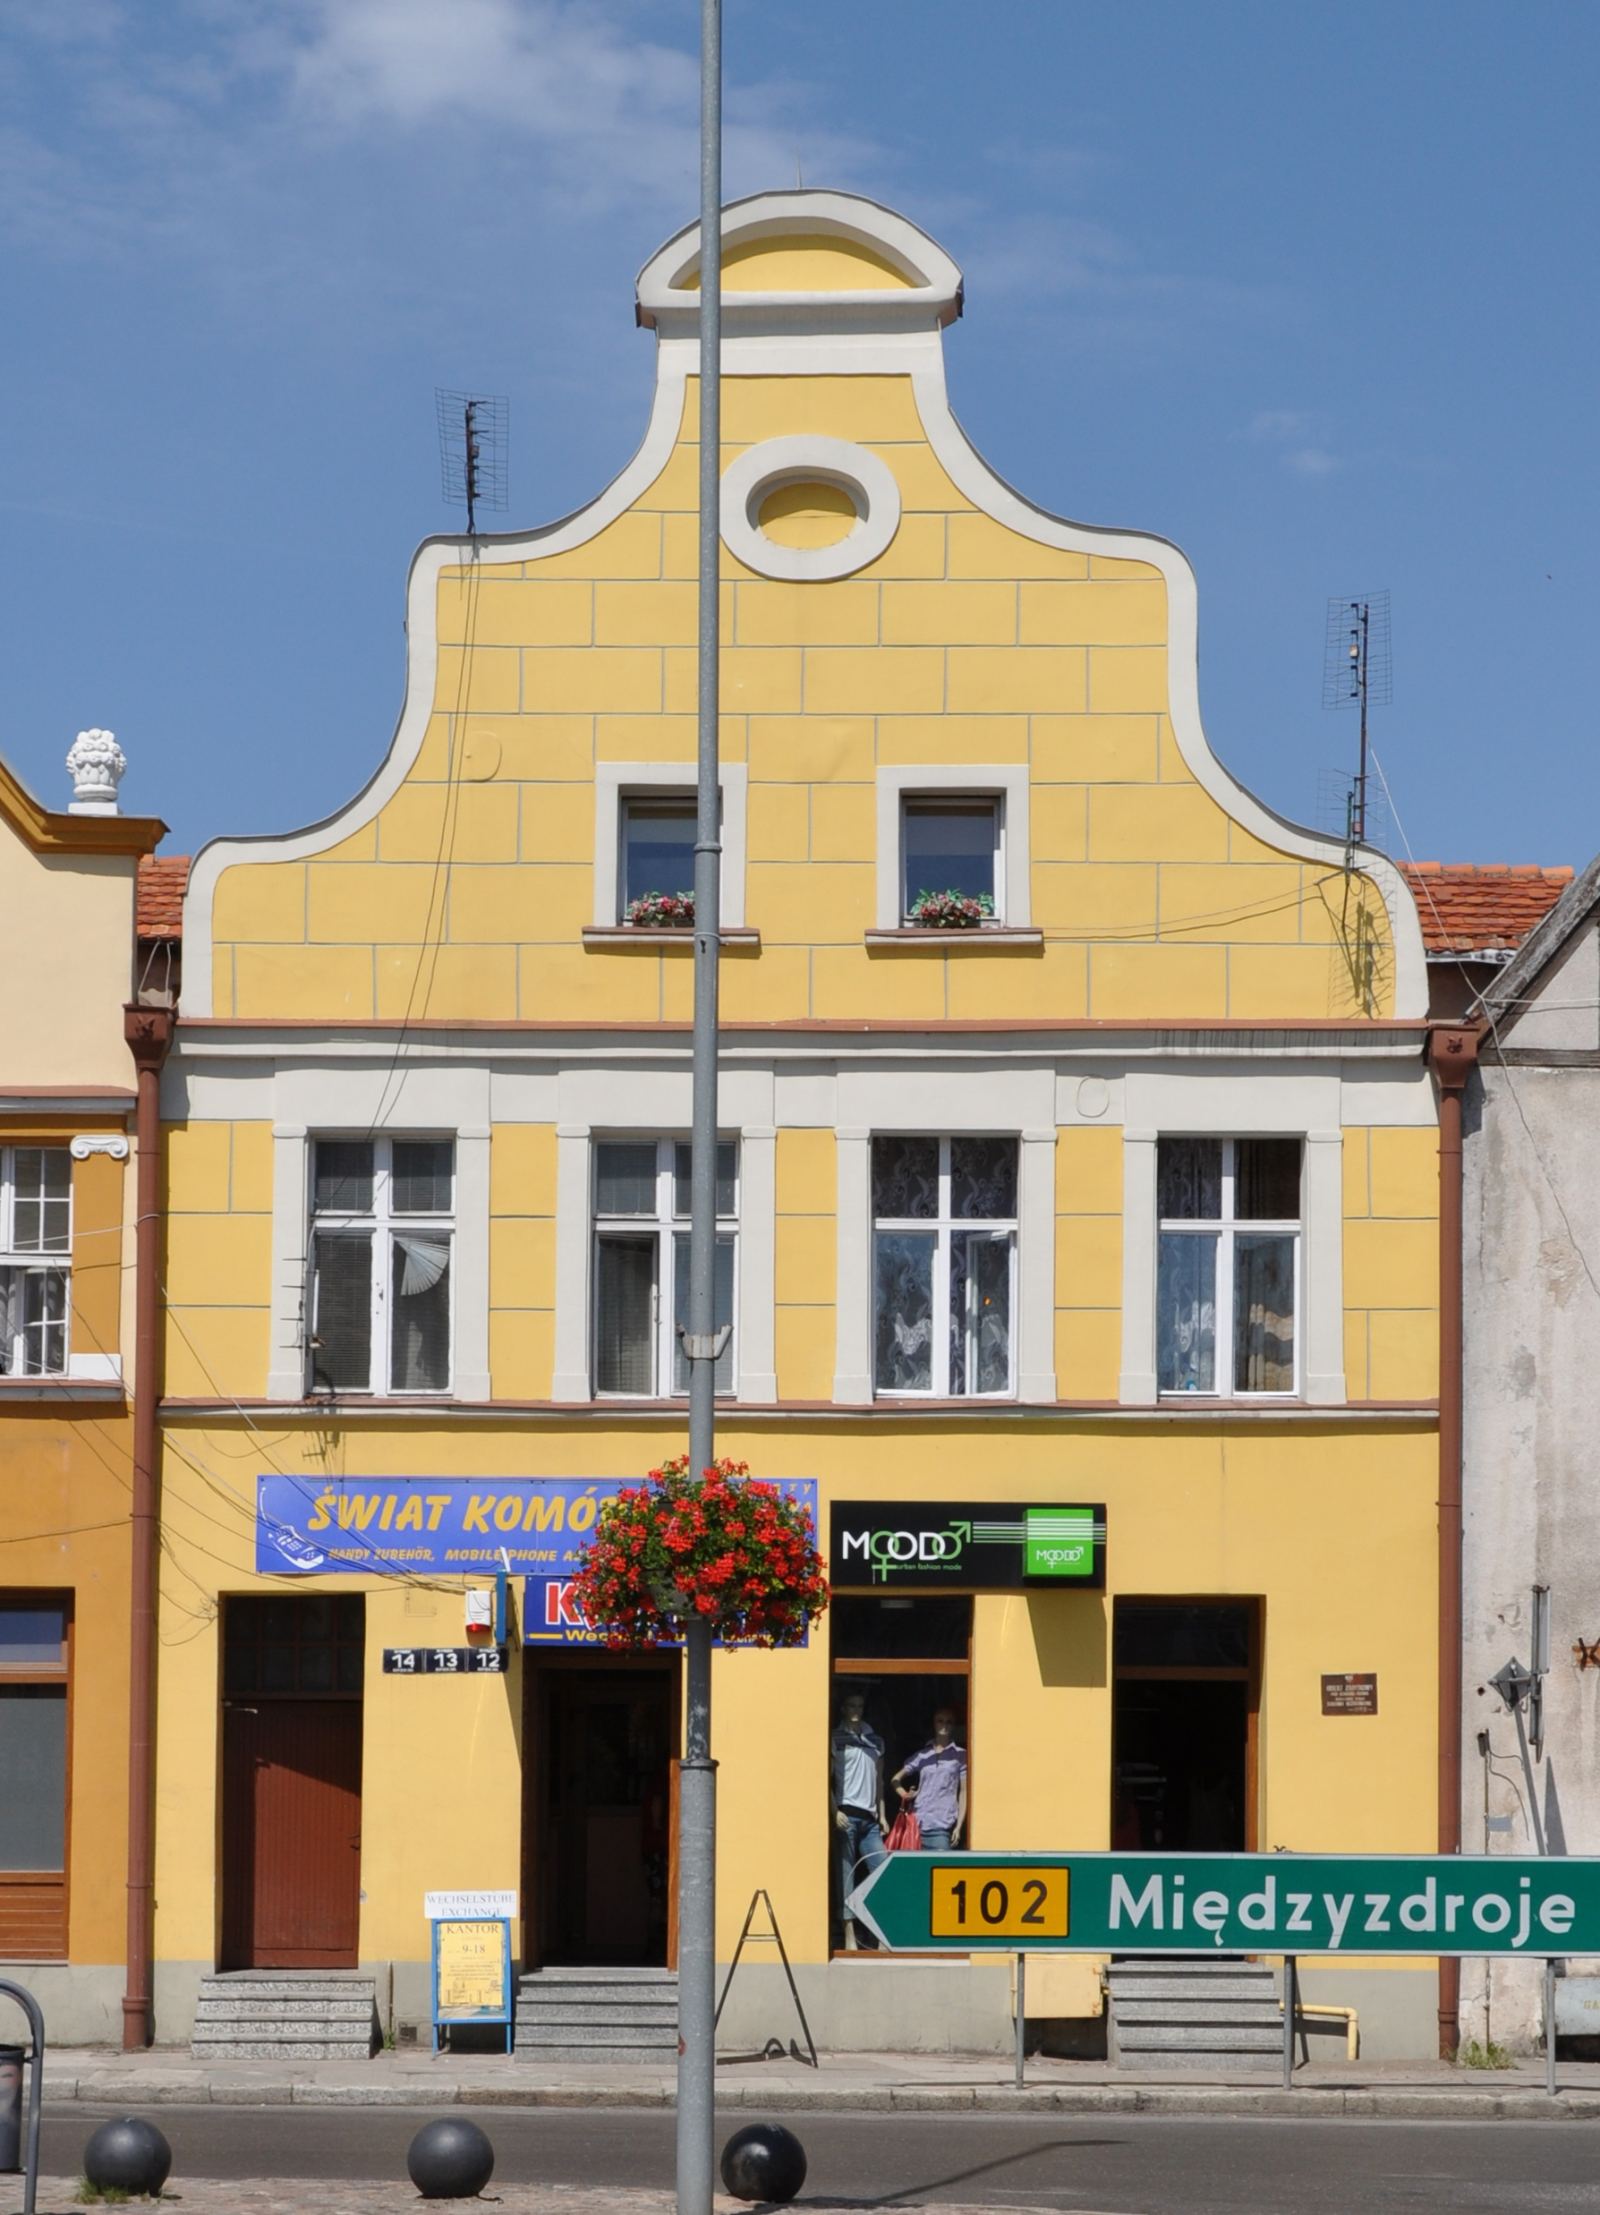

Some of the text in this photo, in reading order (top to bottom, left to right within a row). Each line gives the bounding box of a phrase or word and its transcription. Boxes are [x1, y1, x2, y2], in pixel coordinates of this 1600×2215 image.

[307, 1485, 452, 1531] ŚWIAT
[444, 1548, 502, 1562] MOBILE
[507, 1548, 558, 1562] PHONE
[391, 1653, 416, 1669] 14
[433, 1653, 458, 1668] 13
[476, 1653, 500, 1668] 12
[951, 1873, 1577, 1950] 102 Międzyzdroje
[446, 1924, 499, 1935] KANTOR
